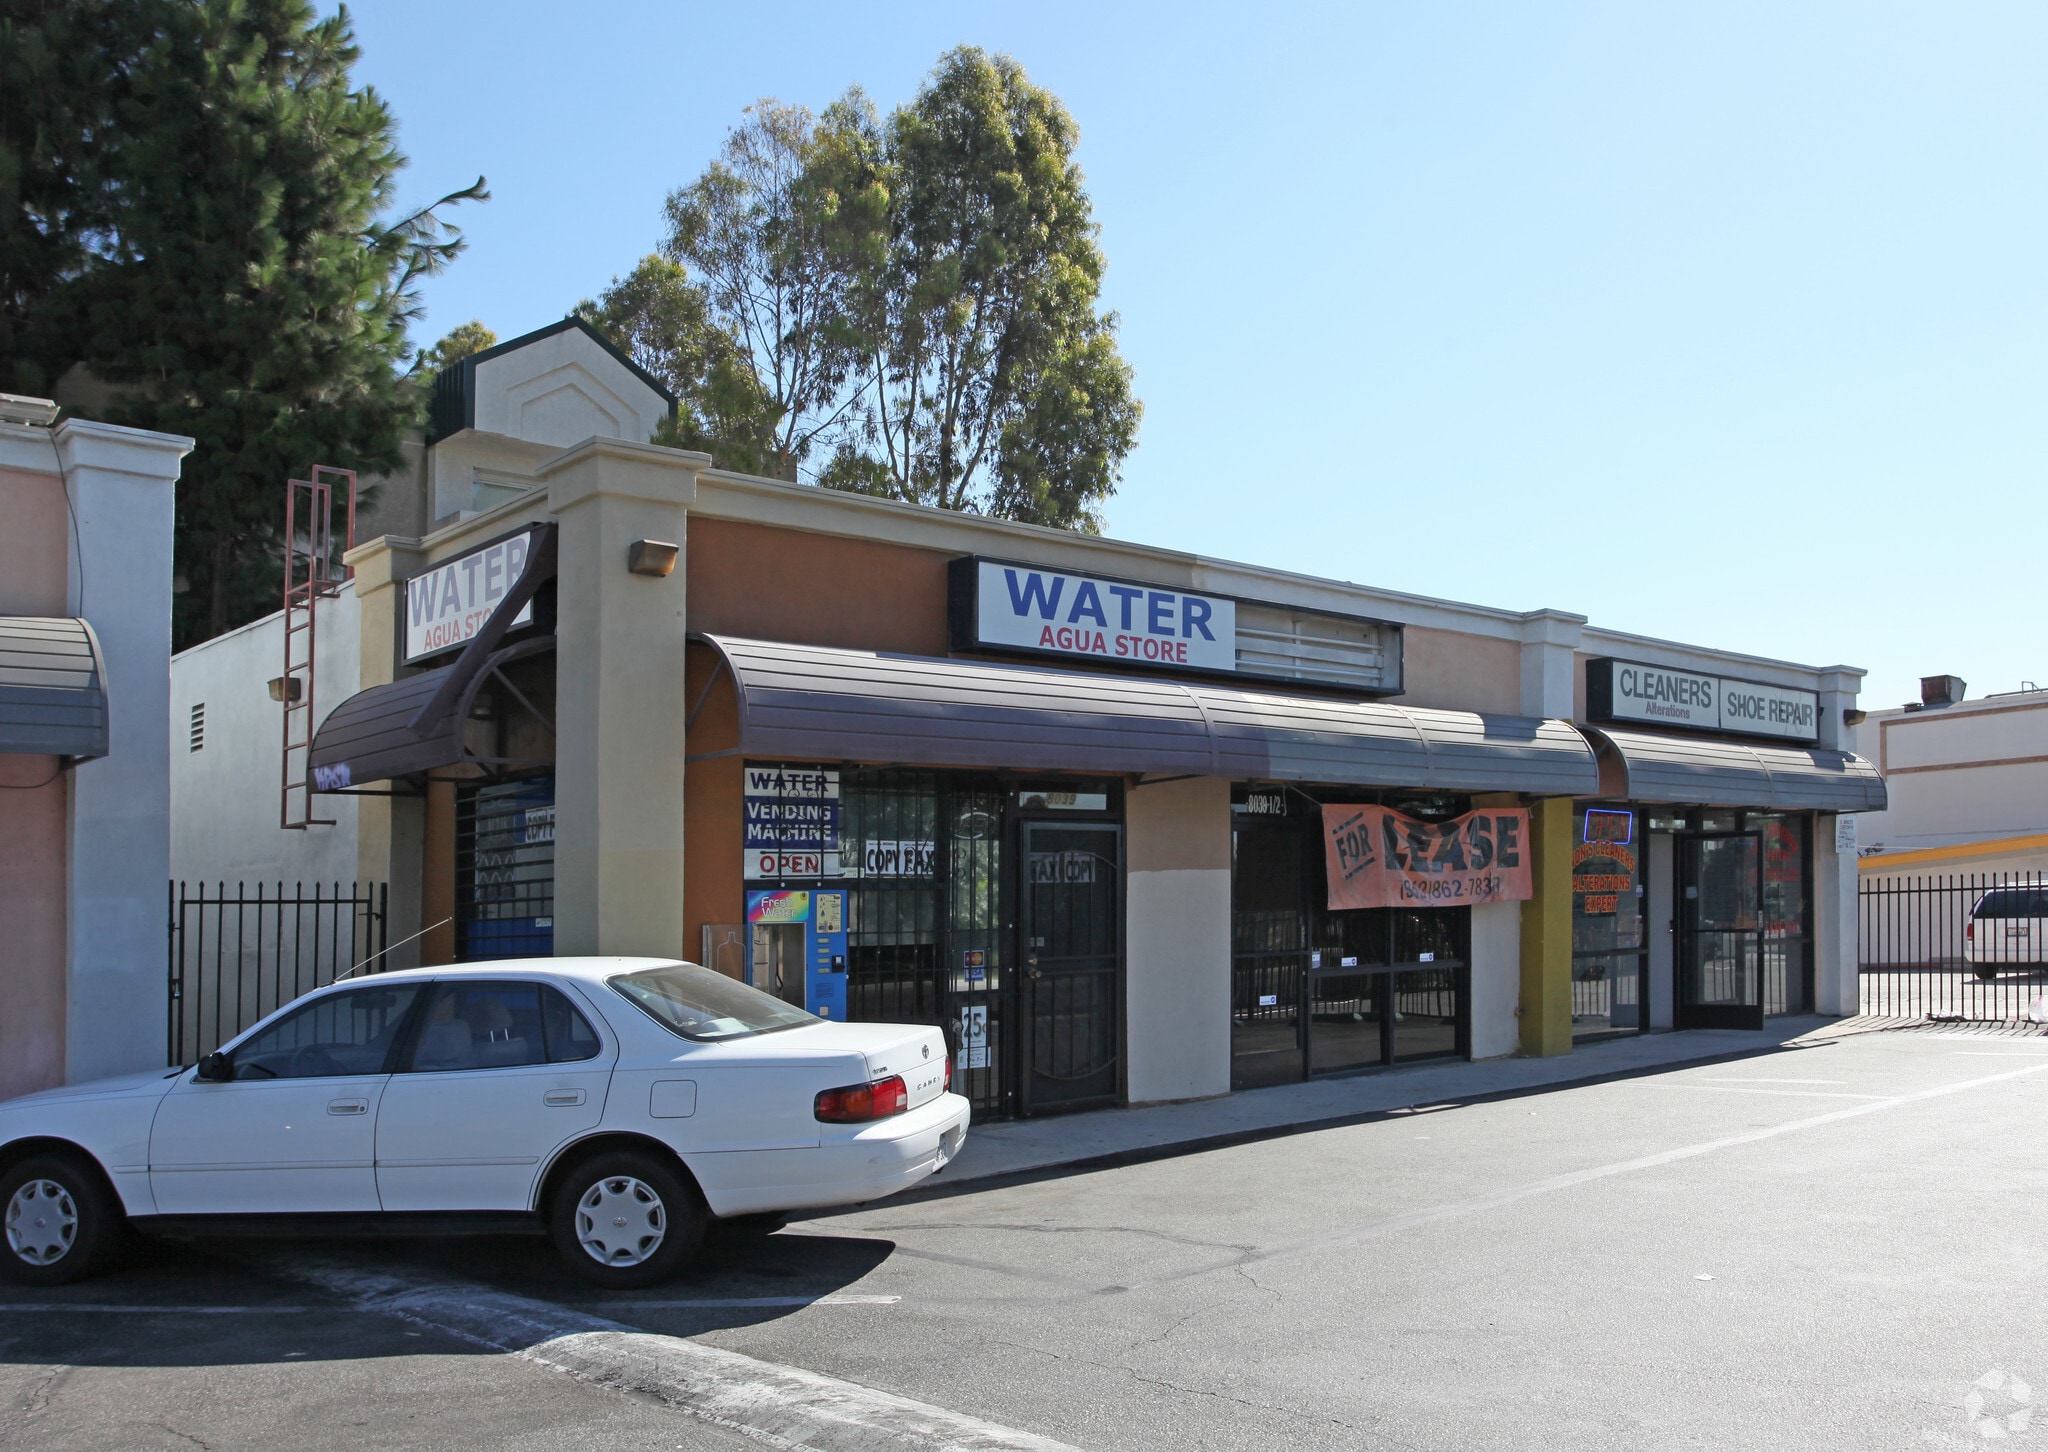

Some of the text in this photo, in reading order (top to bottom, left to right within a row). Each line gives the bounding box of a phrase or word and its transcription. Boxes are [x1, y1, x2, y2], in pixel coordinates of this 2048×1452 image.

[410, 538, 527, 627] WATER
[1004, 568, 1217, 642] WATER
[424, 606, 497, 651] AGUA STO
[1039, 625, 1188, 663] AGUA STORE
[1620, 668, 1712, 708] CLEANERS
[1645, 701, 1691, 719] Alterations
[1727, 692, 1813, 727] SHOE REPAIR
[750, 772, 829, 792] WATER
[747, 802, 831, 820] VENDING
[1047, 793, 1076, 805] 8039
[747, 823, 832, 840] MACHINE
[1587, 812, 1628, 840] OPEN
[1336, 823, 1373, 870] FOR
[1382, 814, 1520, 873] LEASE
[759, 855, 819, 873] OPEN
[867, 849, 935, 873] COPY FAX
[1595, 840, 1636, 874] CLEANERS
[1572, 874, 1631, 892] ALTERATIONS
[761, 897, 793, 908] Fresh
[762, 907, 796, 918] Water
[1585, 895, 1618, 913] EXPERT
